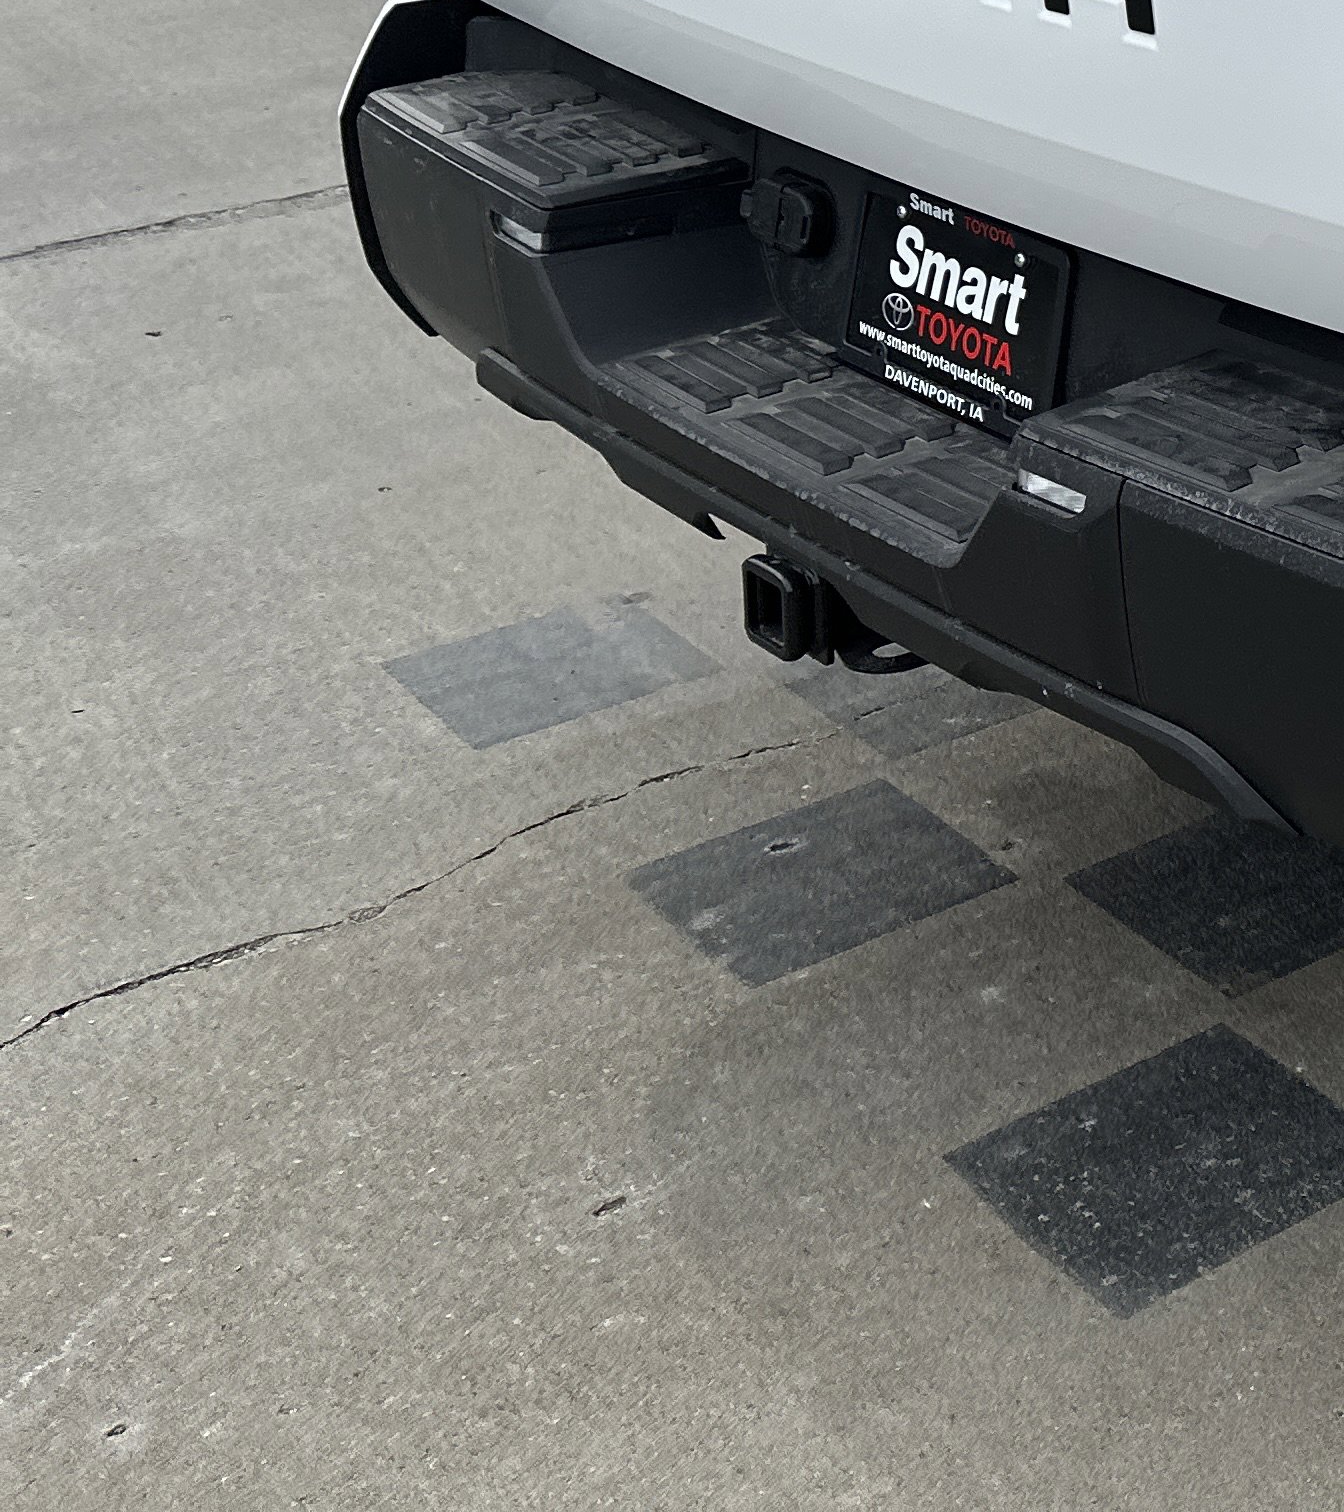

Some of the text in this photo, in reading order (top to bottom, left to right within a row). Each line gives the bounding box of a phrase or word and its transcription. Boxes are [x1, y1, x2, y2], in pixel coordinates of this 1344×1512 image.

[909, 192, 1016, 249] Smart TOYOTA
[889, 224, 1027, 336] Smart
[858, 320, 1034, 411] www.smarttoyotaquadcities.com
[915, 304, 1013, 377] TOYOTA
[884, 363, 985, 423] DAVENPORT, IA
